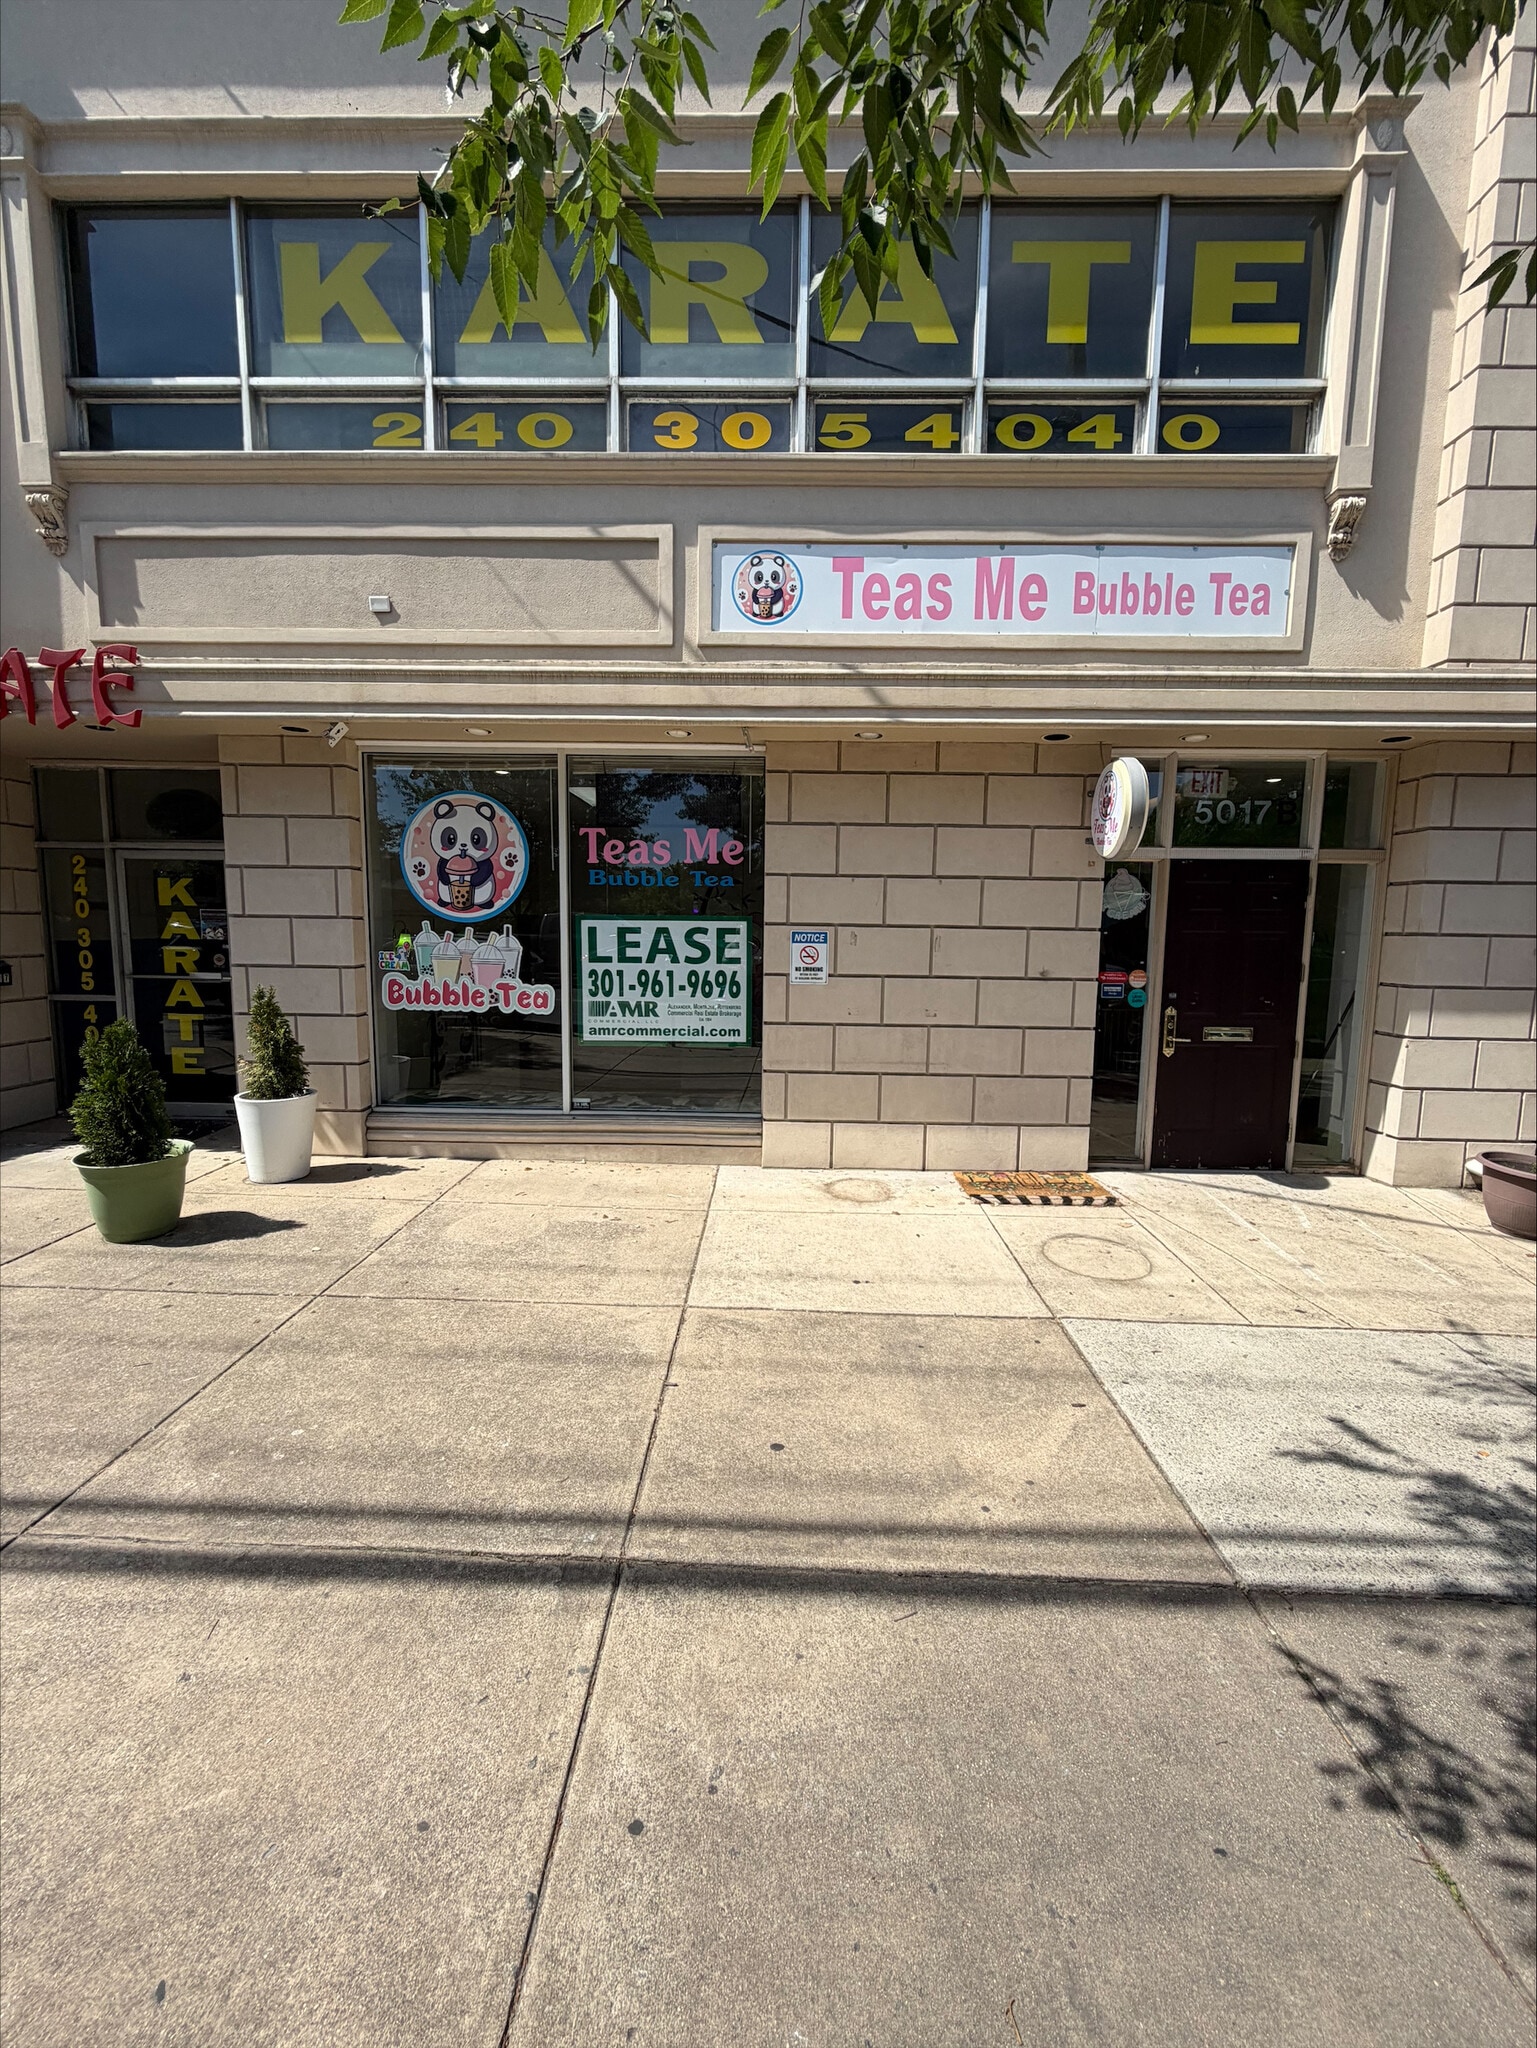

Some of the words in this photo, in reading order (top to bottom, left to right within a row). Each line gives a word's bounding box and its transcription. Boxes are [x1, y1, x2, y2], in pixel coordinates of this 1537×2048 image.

[280, 241, 1306, 345] KARATE
[832, 557, 954, 622] Teas
[974, 557, 1049, 621] Me
[1073, 571, 1196, 617] Bubble
[1209, 572, 1271, 616] Tea
[1191, 770, 1224, 794] EXIT
[579, 827, 671, 865] Teas
[683, 828, 745, 865] Me
[588, 869, 680, 887] Bubble
[689, 871, 734, 887] Tea
[587, 926, 742, 965] LEASE
[794, 933, 826, 942] NOTICE
[379, 952, 394, 960] ICE
[380, 961, 409, 970] CREAM
[157, 877, 206, 1075] KARATE
[588, 969, 741, 998] 301-961-9696
[387, 978, 485, 1008] Bubble
[495, 982, 549, 1010] Tea
[588, 1026, 741, 1037] amrcommercial.com
